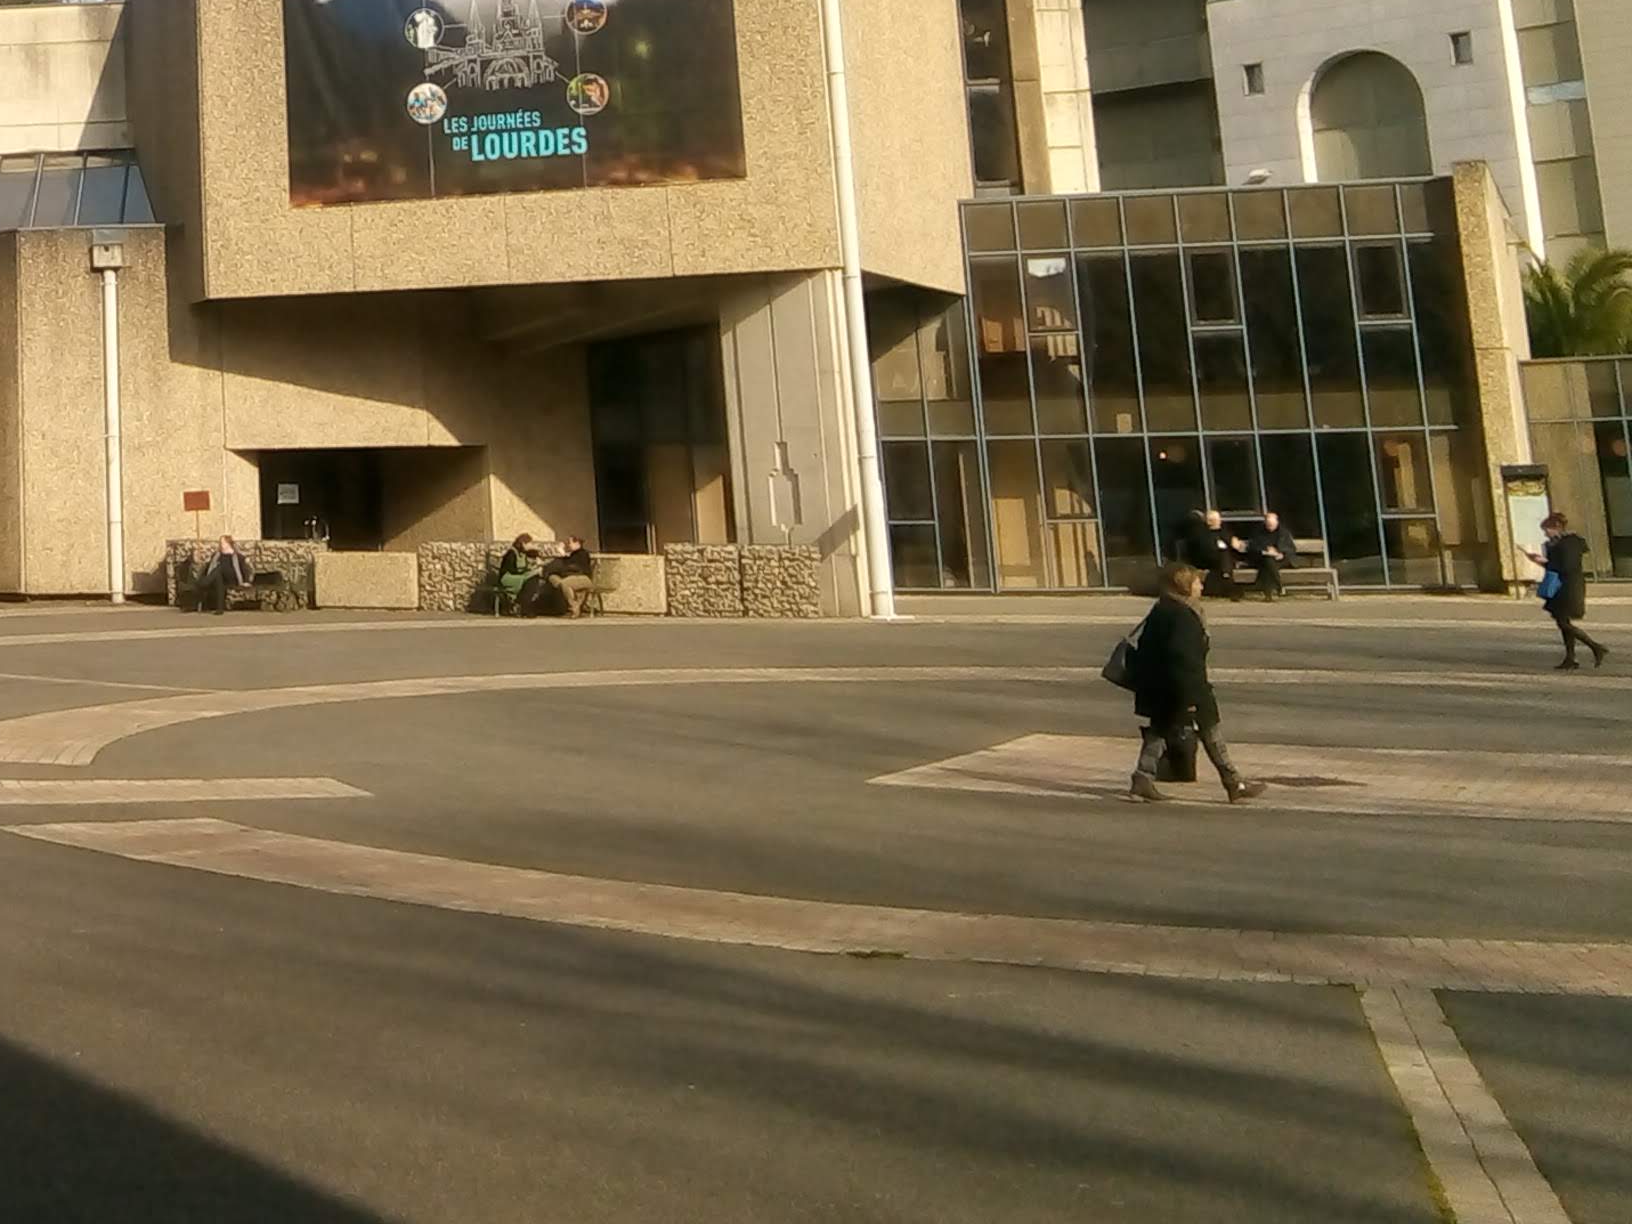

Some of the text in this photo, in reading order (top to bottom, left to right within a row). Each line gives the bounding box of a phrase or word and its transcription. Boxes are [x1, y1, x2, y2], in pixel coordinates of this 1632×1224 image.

[443, 108, 542, 134] LES JOURNÉES
[452, 127, 588, 161] DE LOURDES
